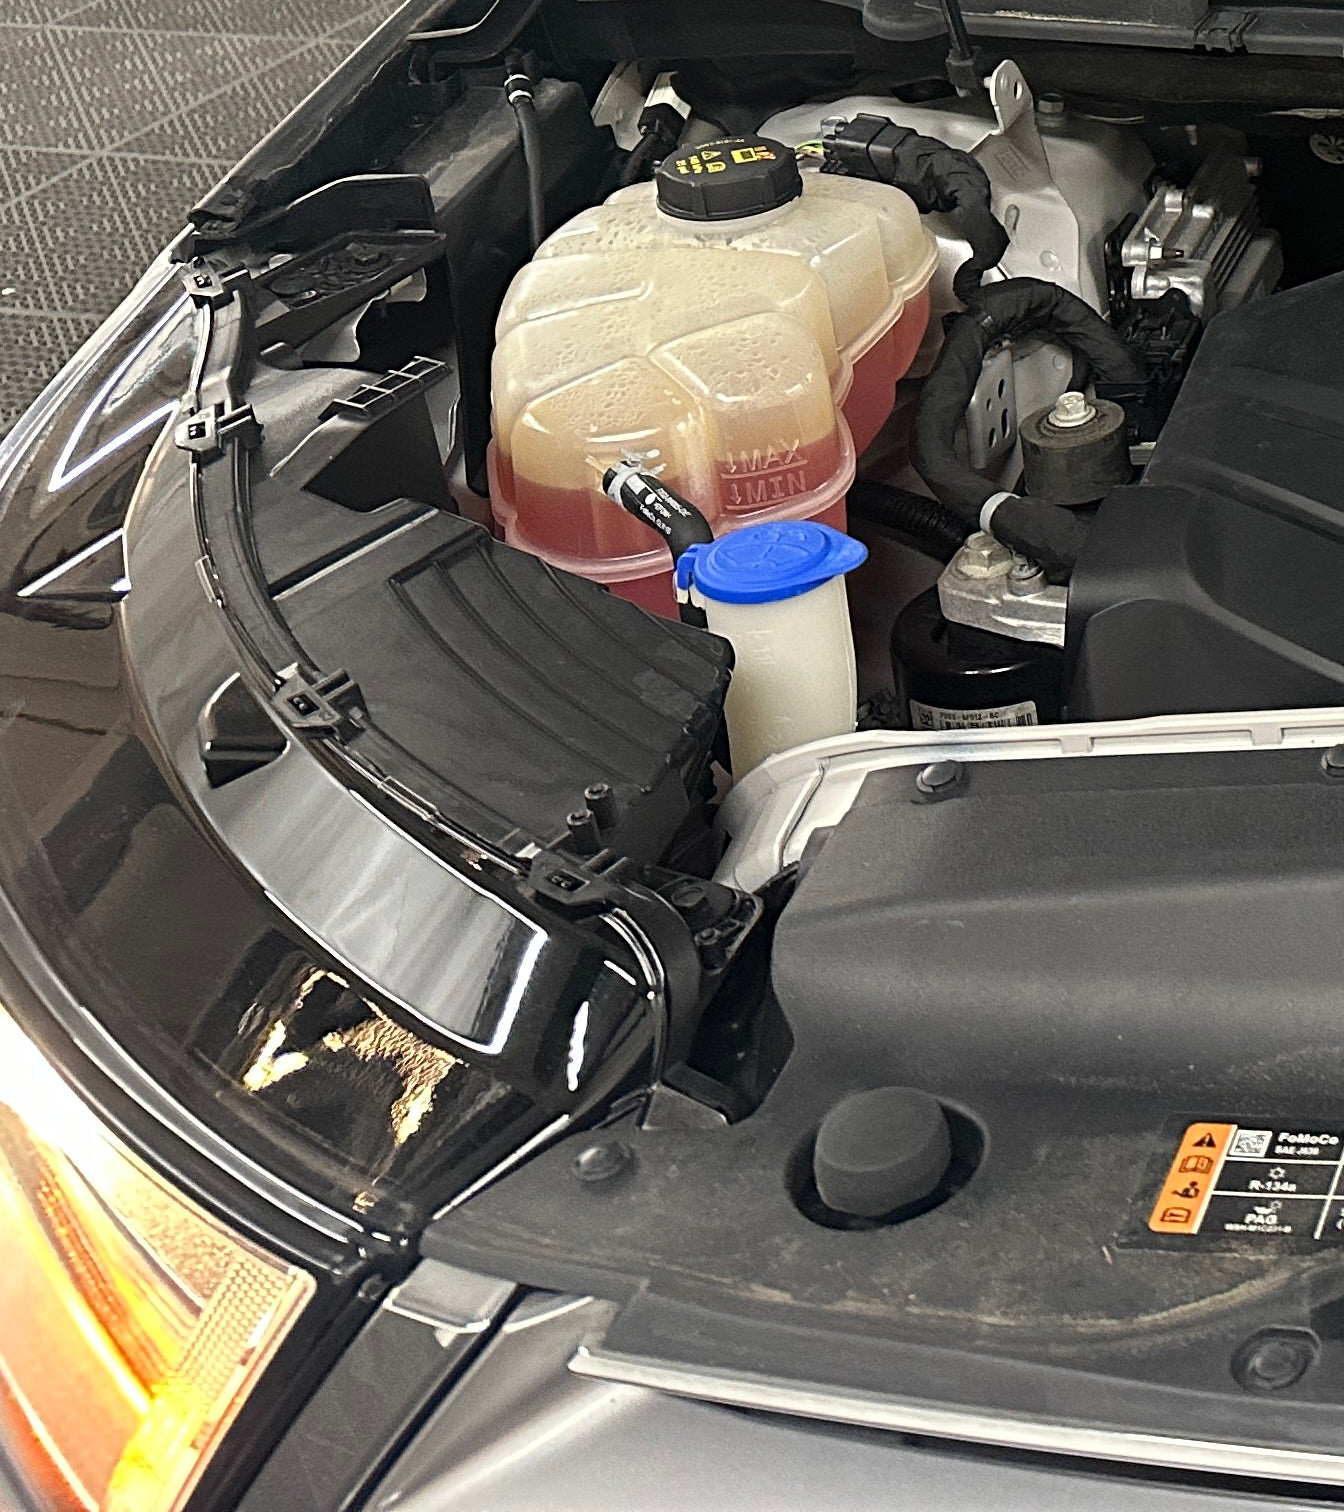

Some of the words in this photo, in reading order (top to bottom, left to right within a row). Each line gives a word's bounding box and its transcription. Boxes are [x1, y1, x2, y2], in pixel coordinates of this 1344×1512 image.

[740, 438, 802, 472] MAX
[745, 471, 806, 504] MIN
[1278, 1132, 1339, 1145] FoMoCo
[1248, 1180, 1296, 1192] R-134a
